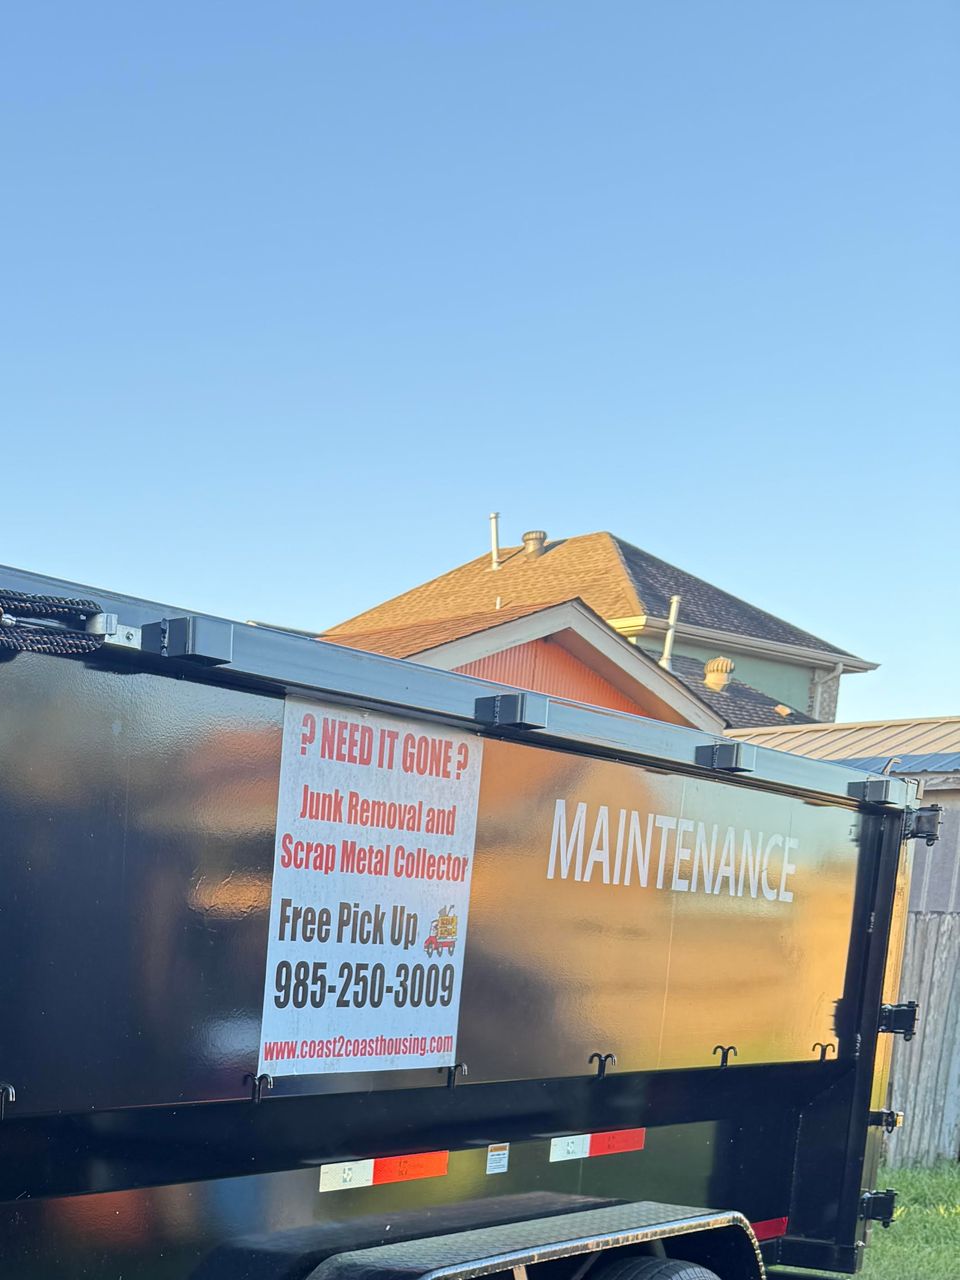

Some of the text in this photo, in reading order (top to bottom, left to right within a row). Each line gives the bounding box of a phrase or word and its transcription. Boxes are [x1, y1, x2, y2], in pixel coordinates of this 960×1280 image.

[320, 717, 374, 766] NEED
[377, 729, 399, 770] IT
[402, 733, 453, 779] GONE
[300, 784, 456, 836] Junk Removal and
[280, 833, 469, 882] Scrap Metal Collector
[546, 799, 799, 903] MAINTENANCE
[278, 898, 331, 943] Free
[336, 901, 386, 945] Pick
[390, 905, 418, 950] Up
[274, 960, 455, 1009] 985-250-3009
[264, 1034, 453, 1061] www.coast2coasthousing.com
